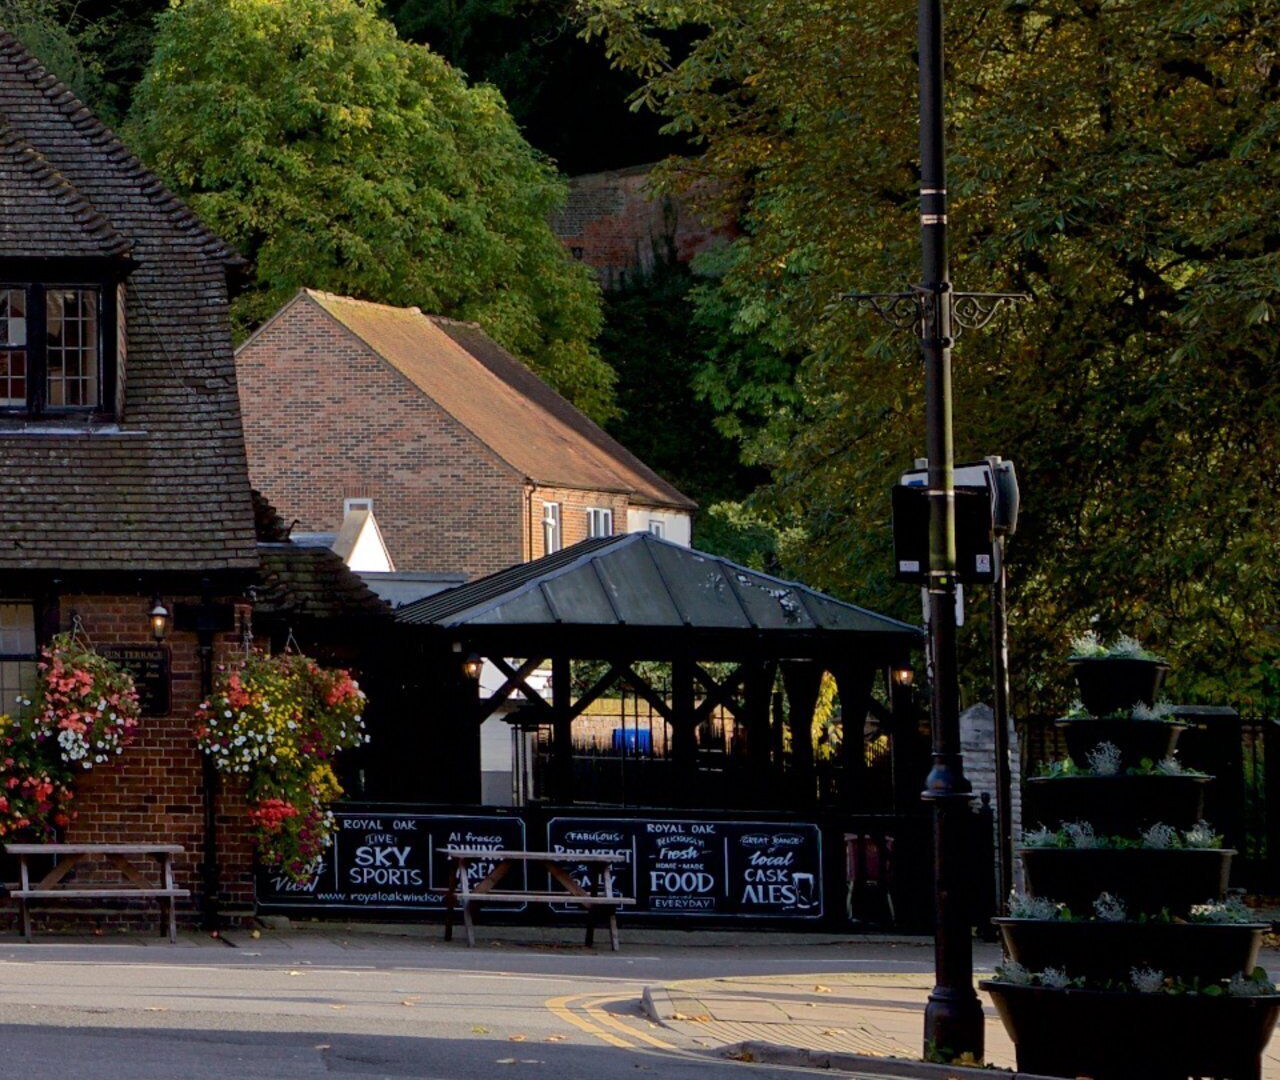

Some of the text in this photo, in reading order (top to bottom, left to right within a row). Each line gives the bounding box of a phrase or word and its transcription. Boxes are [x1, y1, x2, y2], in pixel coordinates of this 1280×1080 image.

[343, 820, 417, 831] ROYAL OAK
[646, 823, 716, 834] ROYAL OAK
[355, 846, 412, 867] SKY
[748, 850, 795, 866] local
[349, 867, 423, 886] SPORTS
[649, 871, 715, 893] FOOD
[744, 868, 790, 883] CASK
[741, 884, 797, 904] ALES
[655, 899, 710, 909] EVERYDAY
